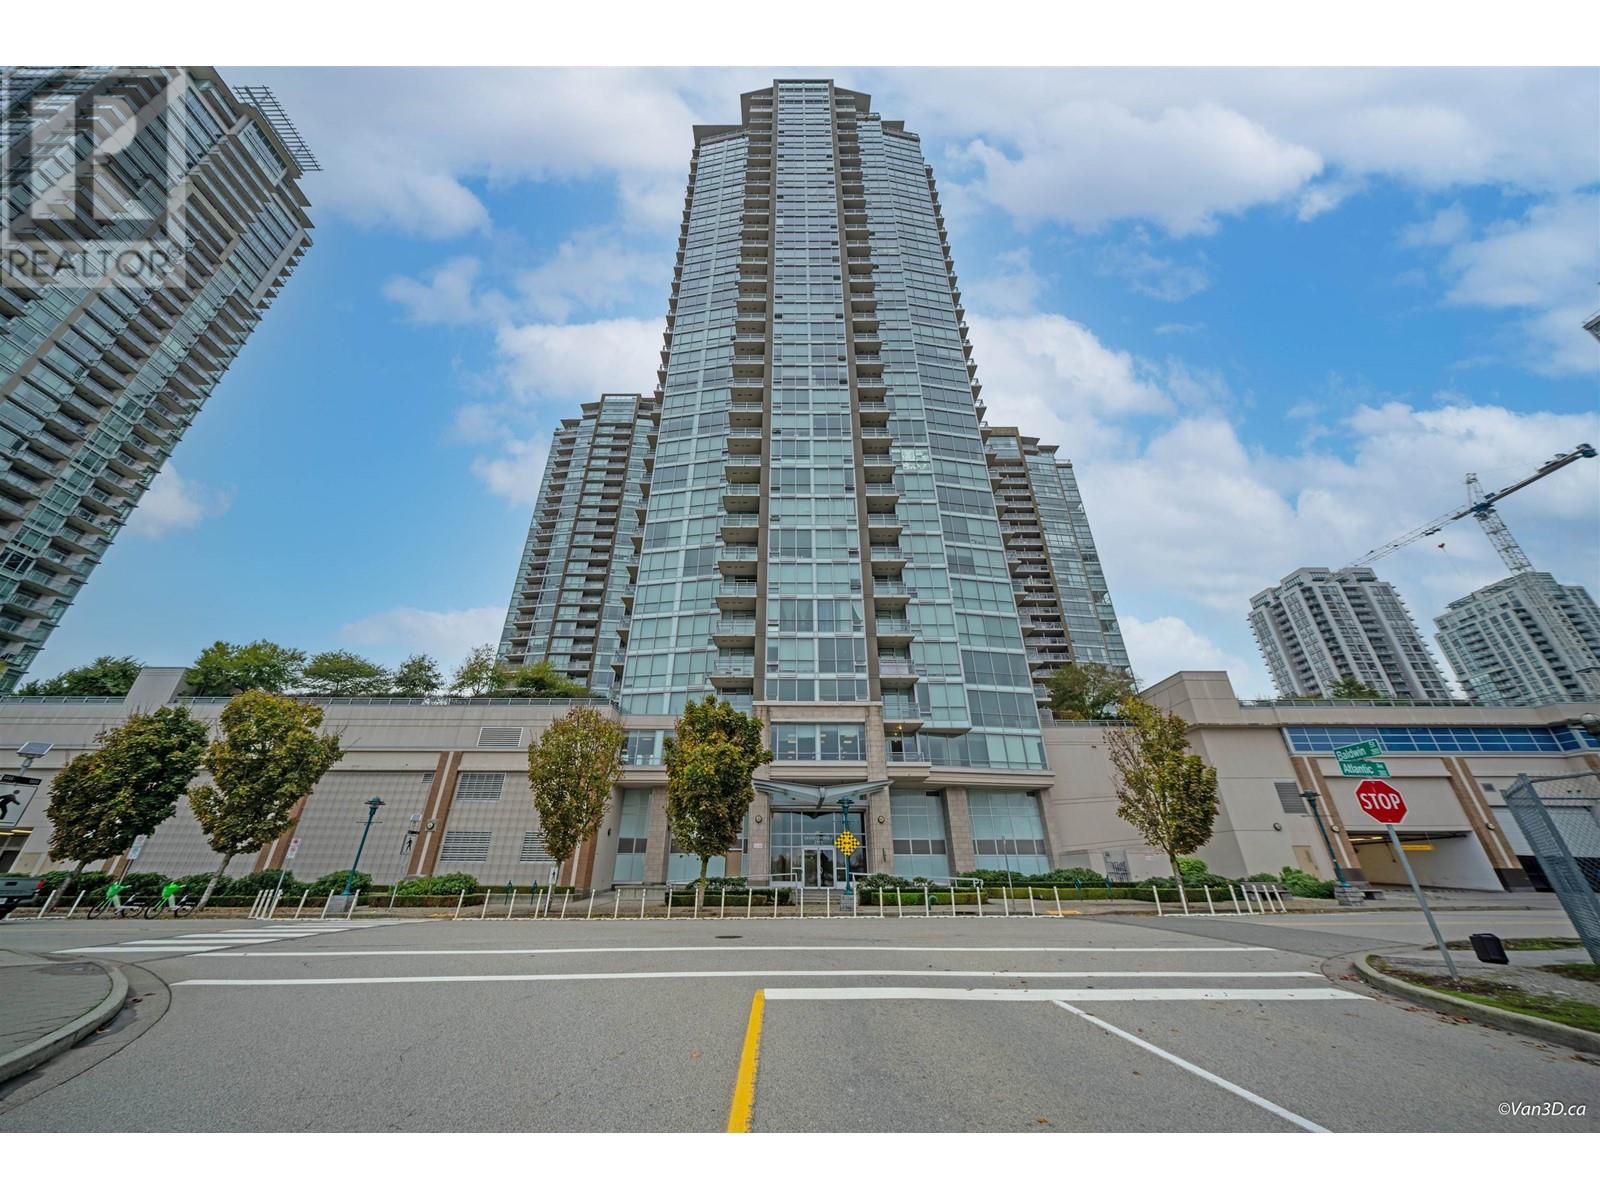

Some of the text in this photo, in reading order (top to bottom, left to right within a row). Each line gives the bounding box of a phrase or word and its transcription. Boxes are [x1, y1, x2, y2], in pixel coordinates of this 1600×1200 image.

[1336, 746, 1367, 760] Baldwin
[1343, 763, 1374, 774] Atlantic
[1360, 793, 1401, 810] STOP
